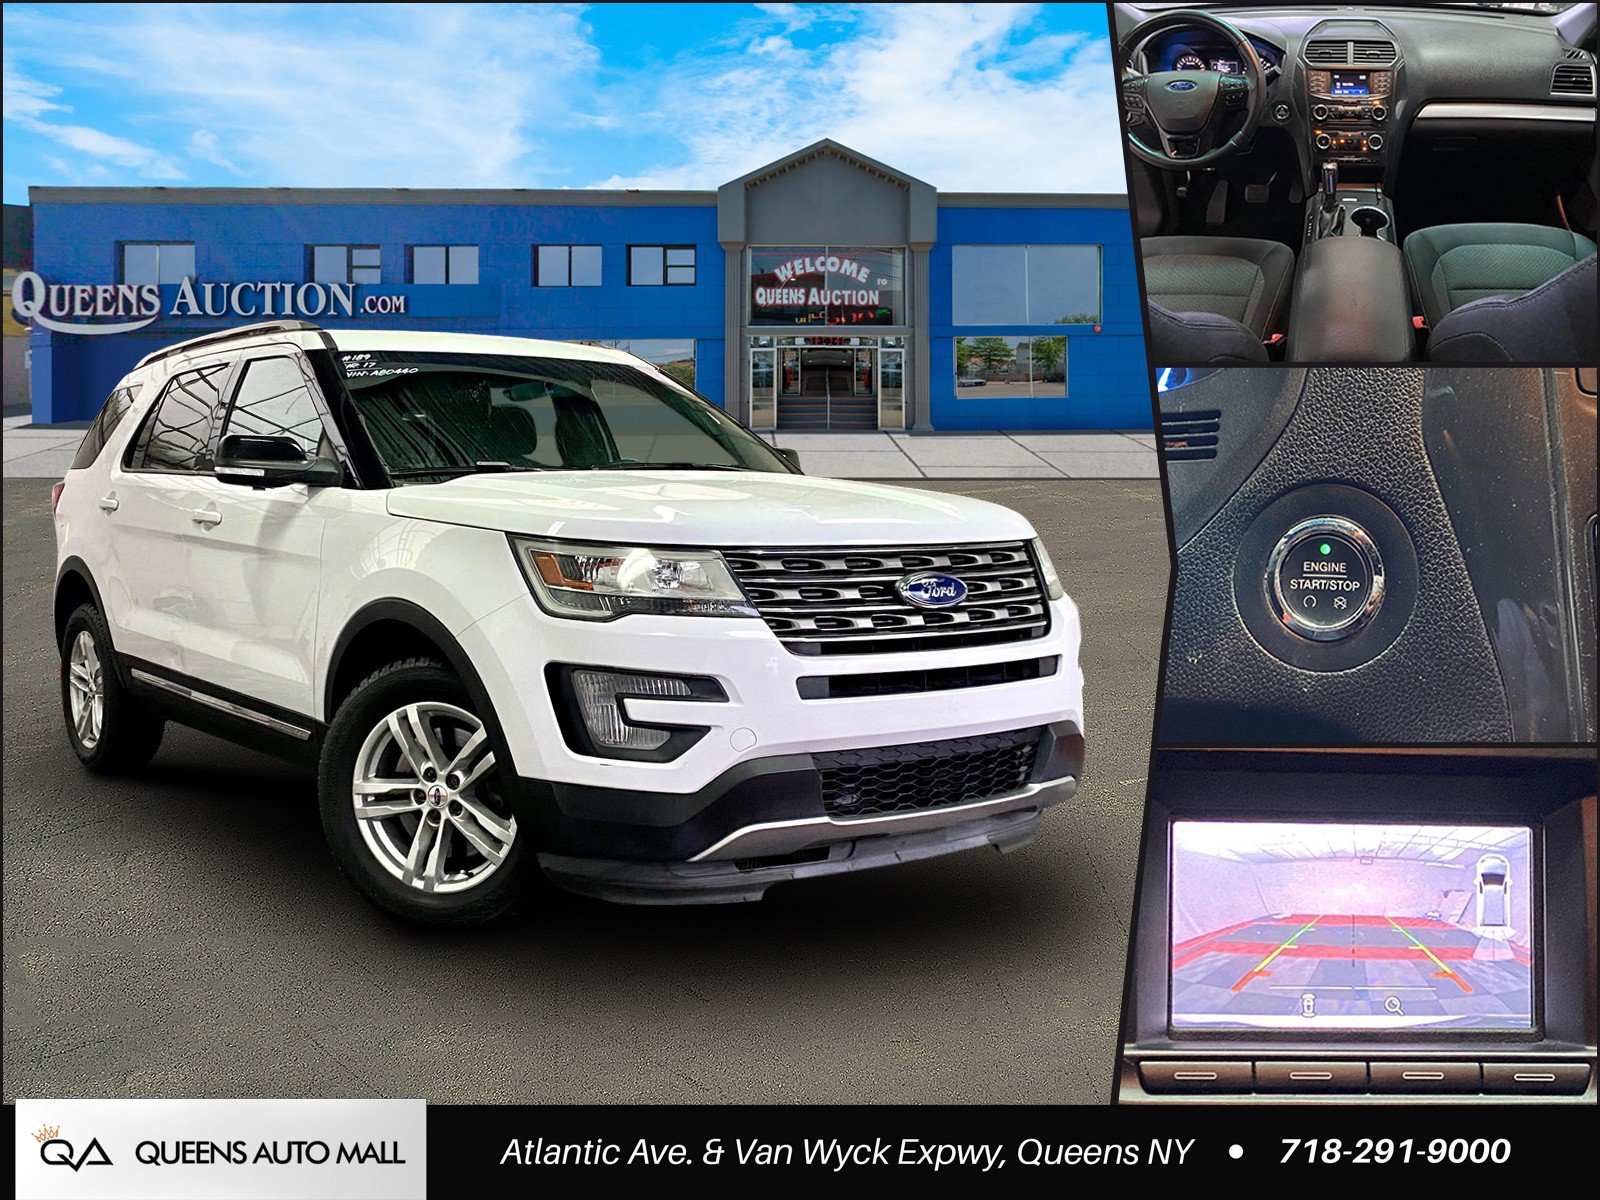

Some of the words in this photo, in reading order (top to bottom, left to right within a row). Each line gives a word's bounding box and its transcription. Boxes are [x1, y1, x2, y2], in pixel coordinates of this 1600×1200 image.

[774, 256, 871, 284] WELCOME
[12, 271, 161, 335] QUEENS
[169, 276, 356, 316] AUCTION
[755, 287, 806, 305] QUEENS
[808, 287, 879, 305] AUCTION
[1303, 561, 1347, 573] ENGINE
[917, 578, 957, 598] Ford
[1290, 578, 1360, 592] START/STOP
